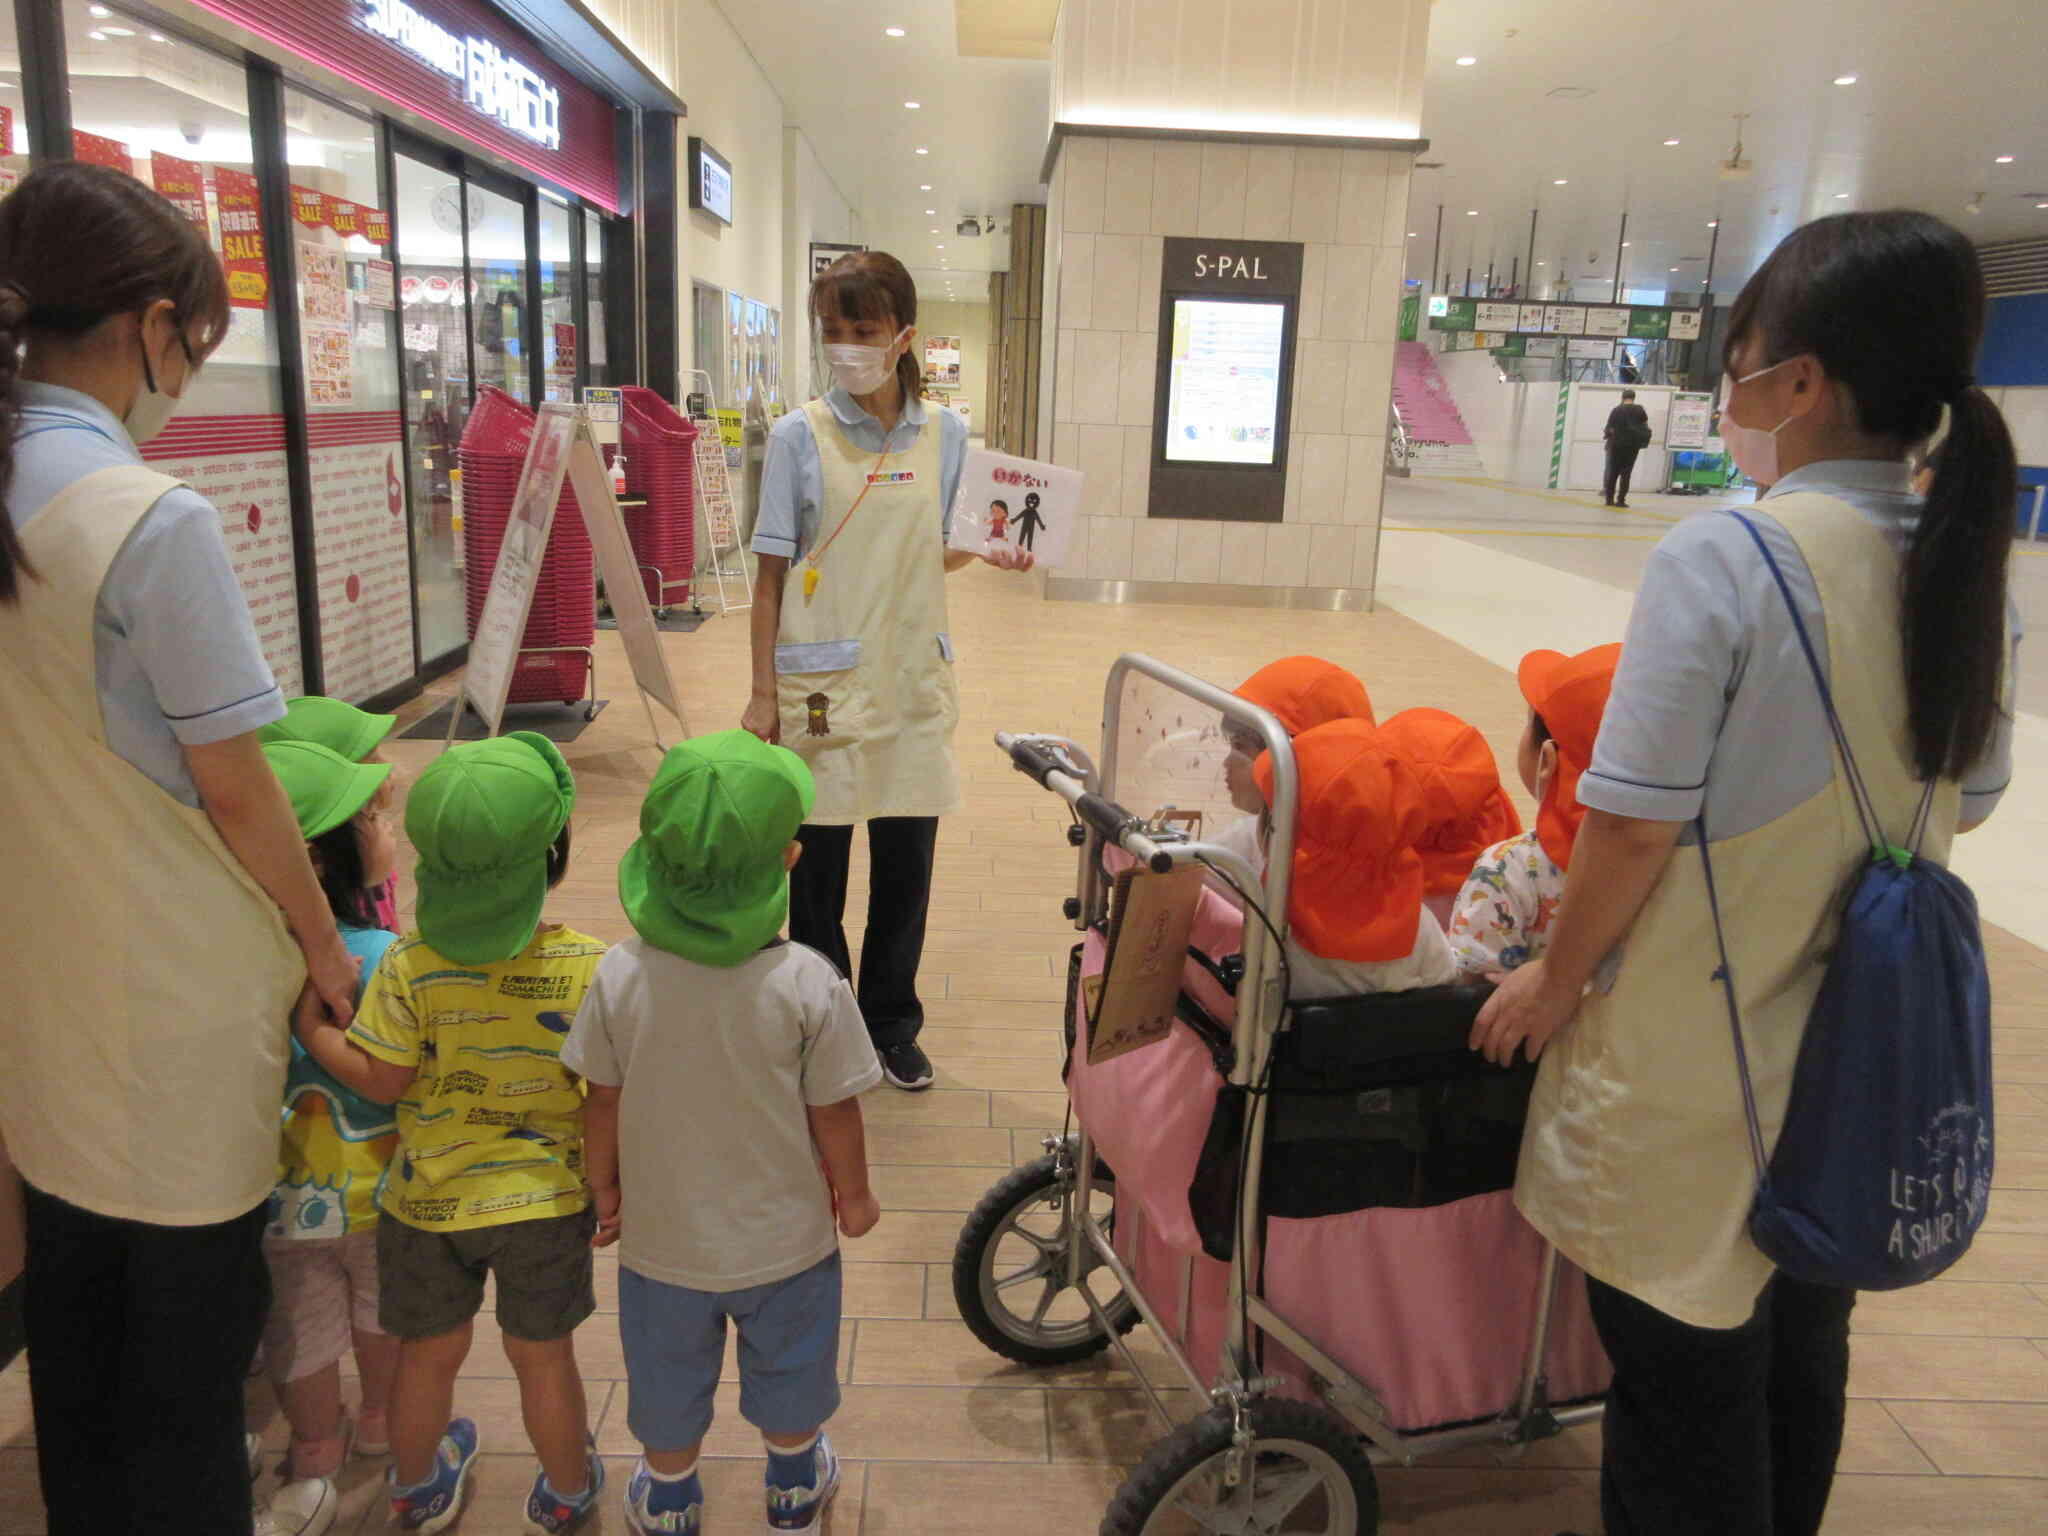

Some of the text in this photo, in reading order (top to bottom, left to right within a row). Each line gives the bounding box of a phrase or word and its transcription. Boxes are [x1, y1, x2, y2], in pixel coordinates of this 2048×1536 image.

[298, 205, 321, 223] SALE
[334, 214, 358, 231] SALE
[367, 223, 389, 240] SALE
[223, 234, 265, 261] SALE
[1194, 254, 1268, 280] S-PAL
